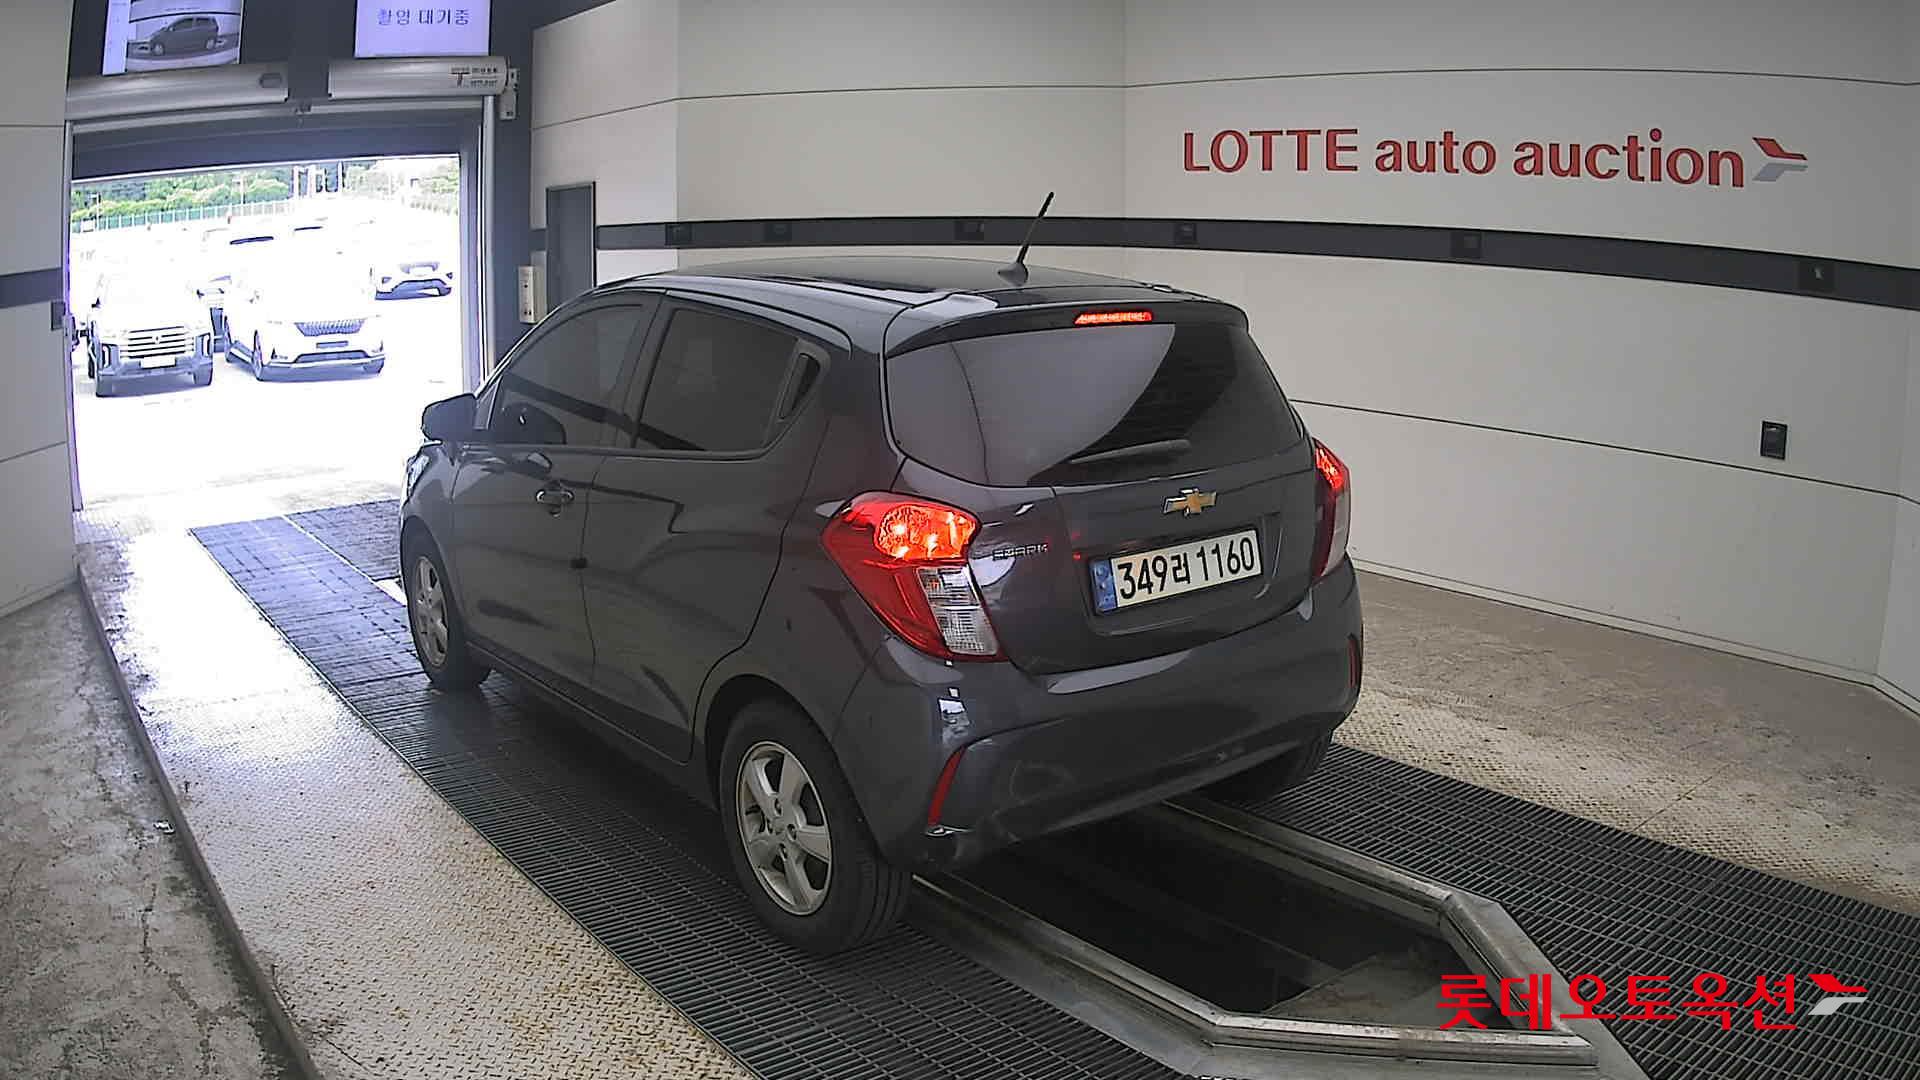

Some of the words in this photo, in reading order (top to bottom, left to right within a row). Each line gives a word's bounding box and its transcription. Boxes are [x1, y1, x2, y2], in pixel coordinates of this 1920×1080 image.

[418, 8, 469, 26] 대기중
[1184, 128, 1358, 173] LOTTE
[1375, 130, 1498, 174] auto
[1512, 128, 1744, 188] auction
[1196, 537, 1255, 581] 1160
